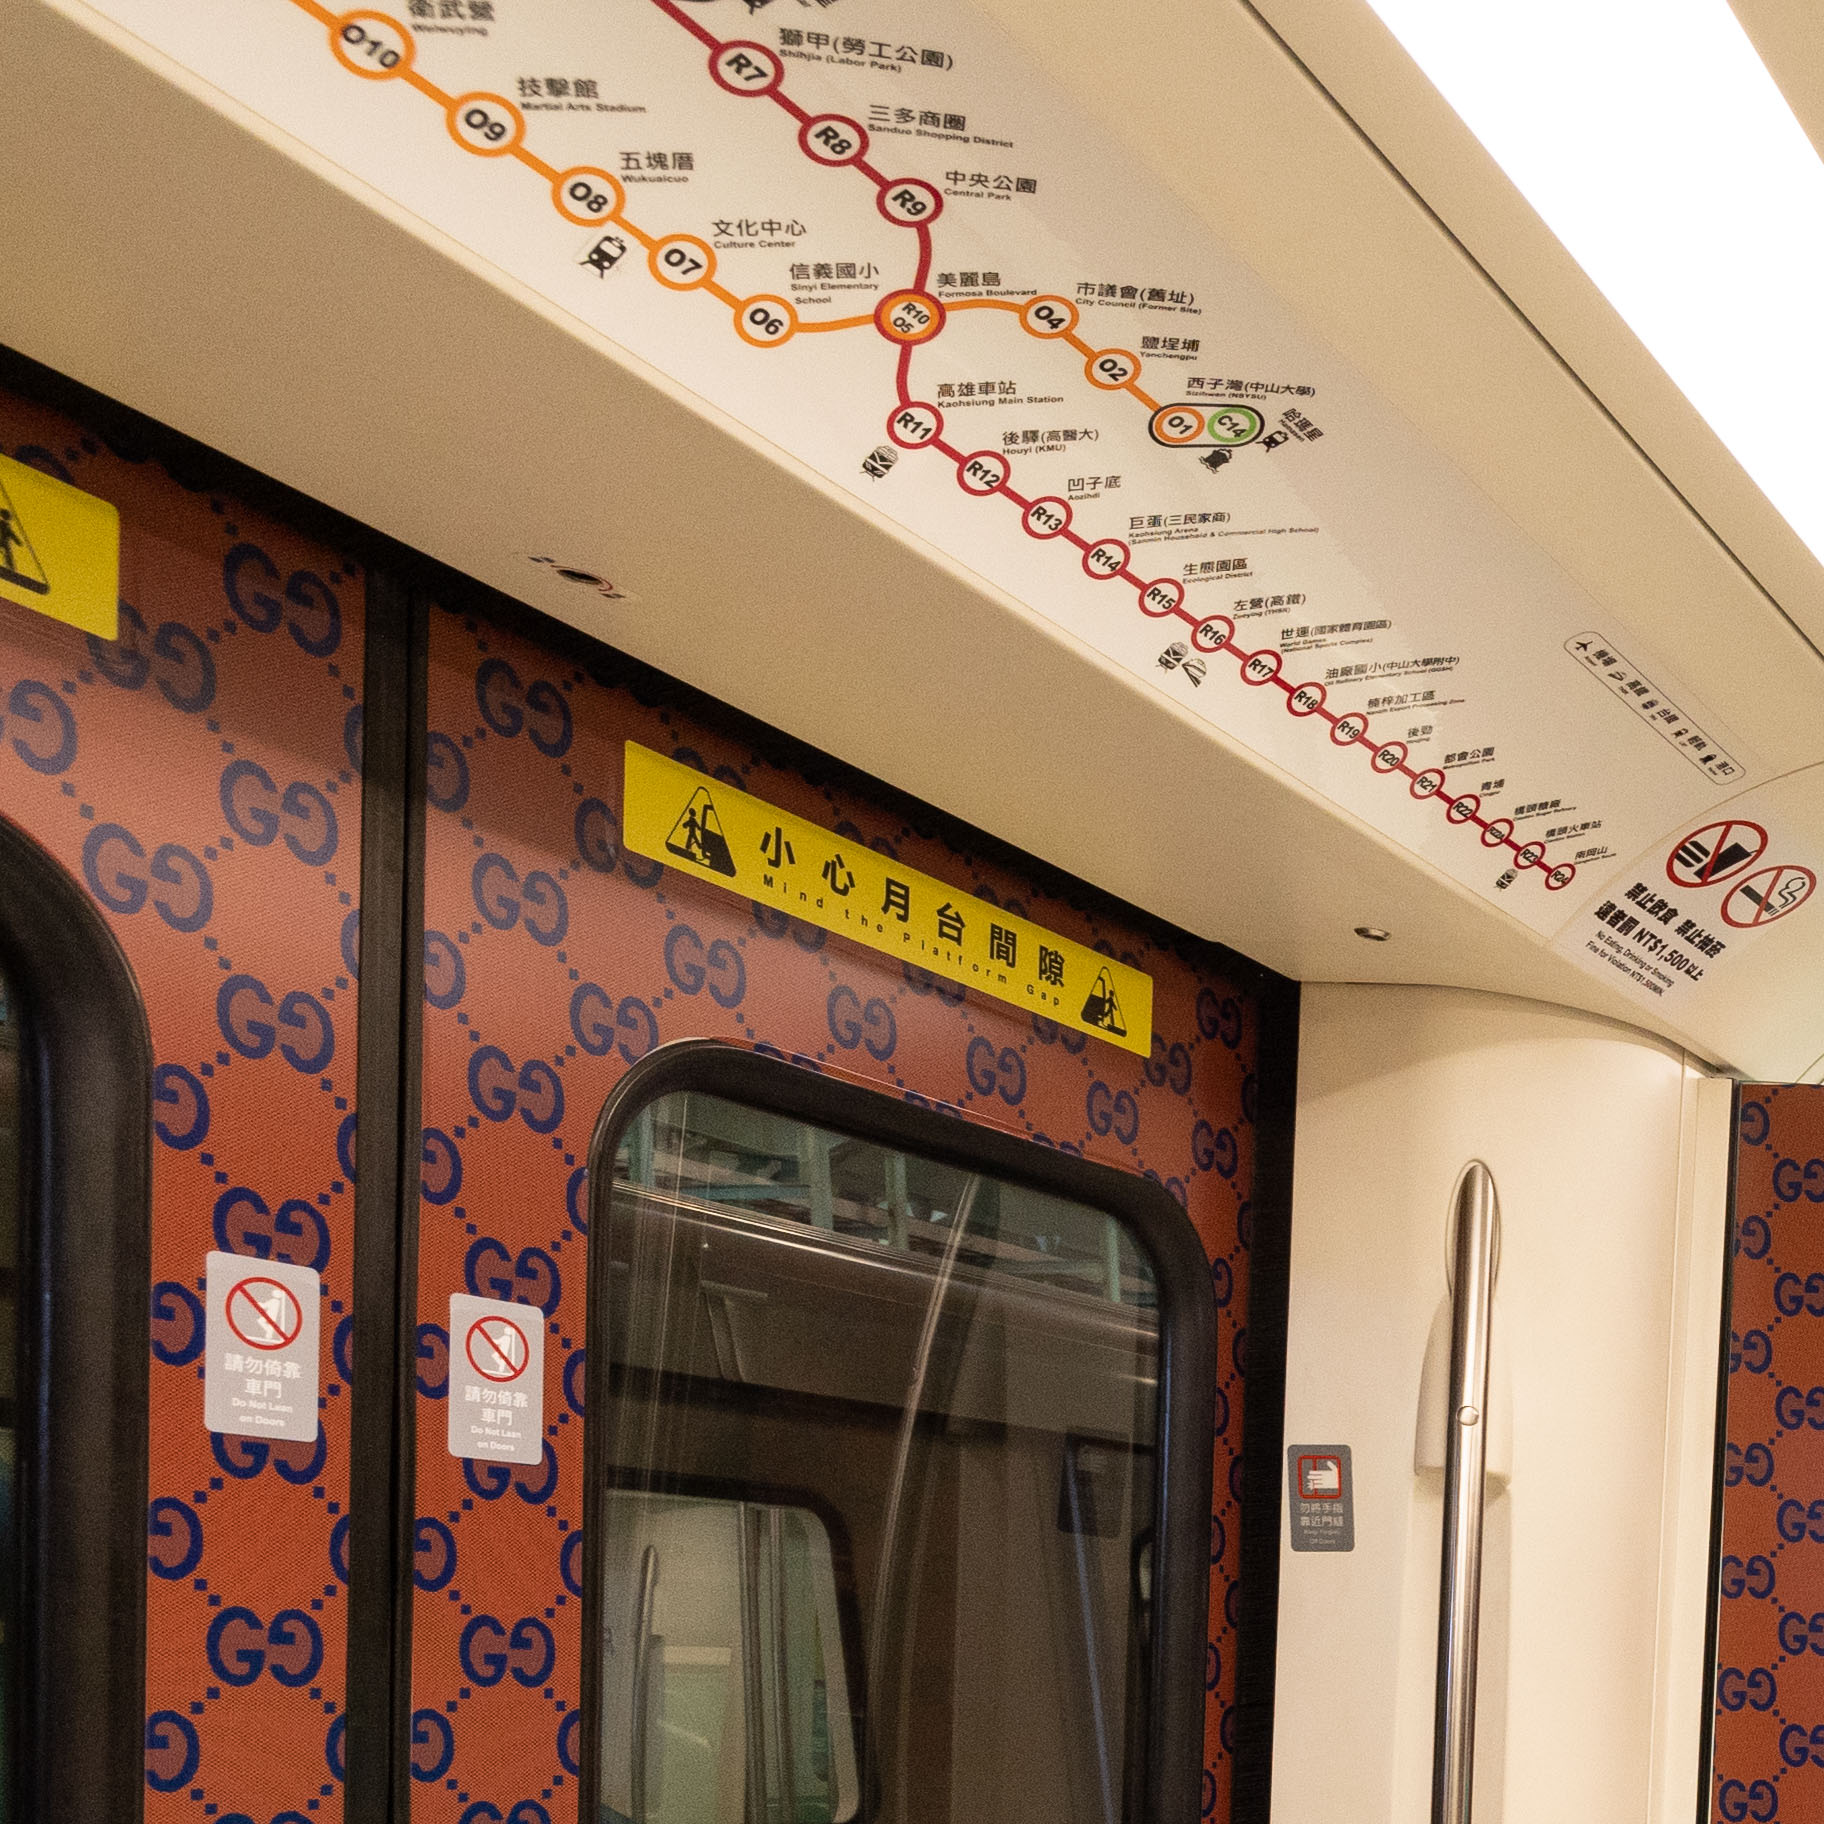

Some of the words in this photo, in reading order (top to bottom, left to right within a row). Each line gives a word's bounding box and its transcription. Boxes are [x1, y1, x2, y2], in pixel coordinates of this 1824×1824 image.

[342, 24, 400, 69] O10
[778, 27, 954, 71] 獅甲(勞工公園)
[725, 53, 768, 81] R7
[825, 54, 866, 68] (Labor
[869, 60, 902, 73] Park)
[517, 75, 599, 99] 技擊館
[521, 102, 563, 112] Martial
[566, 102, 591, 112] Arts
[596, 102, 647, 113] Stadium
[868, 104, 966, 131] 三多商圈
[465, 109, 506, 141] O9
[814, 126, 852, 156] R8
[868, 123, 913, 136] Sanduo
[916, 128, 970, 144] Shopping
[973, 136, 1014, 148] District
[619, 151, 694, 172] 五塊厝
[621, 174, 689, 184] Wukuaicuo
[945, 170, 1038, 194] 中央公園
[569, 182, 609, 213] O8
[891, 188, 927, 217] R9
[944, 188, 984, 199] Central
[987, 192, 1012, 201] Park
[711, 219, 807, 238] 文化中心
[714, 240, 756, 249] Culture
[758, 240, 796, 248] Center
[664, 248, 703, 275] O7
[789, 262, 879, 281] 信義國小
[790, 283, 818, 292] Sinyi
[820, 282, 879, 291] Elementary
[936, 271, 1001, 288] 美麗島
[795, 296, 832, 305] School
[938, 290, 983, 298] Formosa
[985, 288, 1037, 297] Boulevard
[1076, 282, 1195, 306] 市議會(舊址)
[901, 302, 930, 325] R10
[1075, 298, 1095, 306] City
[1097, 299, 1137, 309] Council
[1138, 302, 1177, 312] (Former
[1180, 306, 1203, 315] Site)
[749, 307, 785, 337] O6
[892, 316, 914, 335] O5
[1034, 305, 1066, 330] O4
[1141, 335, 1200, 352] 鹽埕埔
[1098, 358, 1129, 382] O2
[937, 381, 1016, 398] 高雄車站
[1186, 377, 1316, 398] 西子灣(中山大學)
[938, 399, 996, 409] Kaohsiung
[998, 397, 1024, 406] Main
[1026, 395, 1064, 404] Station
[897, 411, 932, 441] R11
[1168, 415, 1193, 435] O1
[1217, 415, 1248, 438] C14
[1002, 429, 1099, 447] 後驛(高醫大)
[1002, 445, 1032, 455] Houyi
[1034, 443, 1067, 454] (KMU)
[966, 460, 1001, 488] R12
[1067, 475, 1122, 492] 凹子底
[1031, 506, 1062, 532] R13
[1129, 511, 1232, 530] 巨蛋(三民家商)
[1175, 526, 1199, 534] Arena
[1090, 548, 1122, 573] R14
[1183, 557, 1249, 576] 生態園區
[1182, 574, 1224, 584] Ecological
[1225, 571, 1254, 580] District
[1147, 587, 1174, 610] R15
[1199, 623, 1226, 646] R16
[1248, 658, 1274, 678] R17
[1294, 690, 1317, 710] R18
[1337, 720, 1360, 740] R19
[1378, 749, 1400, 767] R20
[1416, 776, 1437, 792] R21
[1452, 801, 1474, 818] R22
[1519, 848, 1538, 863] R23
[758, 826, 1066, 989] 小心月台間隙
[1624, 882, 1680, 926] 禁止飲食
[1594, 900, 1640, 937] 違者罰
[762, 873, 825, 908] Mind
[844, 908, 884, 932] the
[903, 931, 1008, 986] Platform
[1026, 983, 1061, 1007] Gap
[1585, 940, 1600, 954] Fine
[1607, 954, 1632, 974] Violation
[1595, 930, 1606, 941] No
[1623, 948, 1647, 970] Drinking
[1651, 967, 1675, 989] Smoking
[245, 1378, 282, 1399] 車門
[248, 1399, 265, 1411] Not
[480, 1408, 512, 1426] 車門
[484, 1426, 498, 1437] Not
